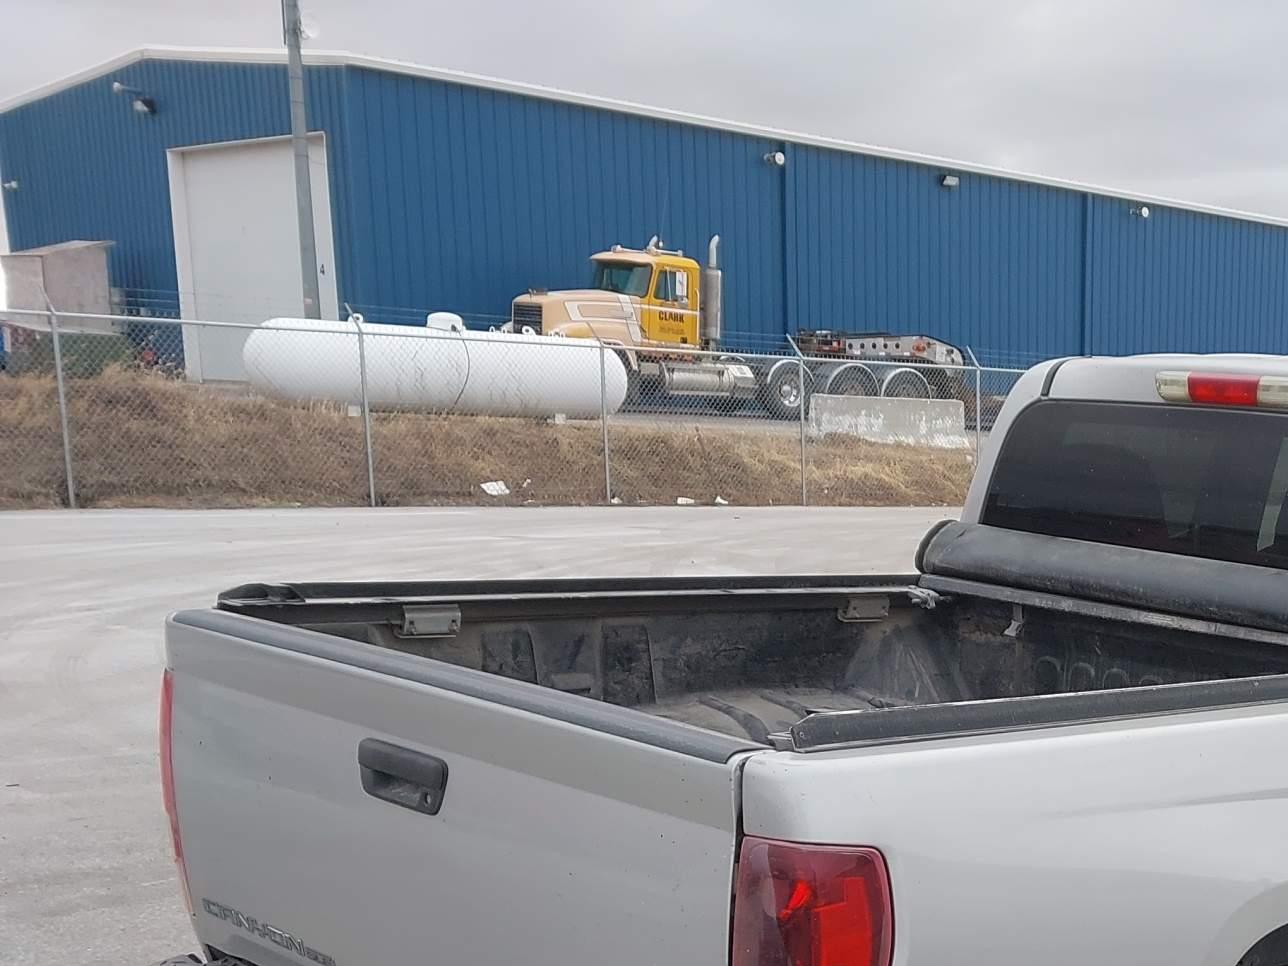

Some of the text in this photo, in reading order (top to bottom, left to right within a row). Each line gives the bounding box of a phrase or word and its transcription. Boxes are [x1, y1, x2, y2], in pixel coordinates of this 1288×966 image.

[319, 263, 326, 276] 4
[658, 310, 685, 324] CLARK
[202, 898, 306, 957] CANYON
